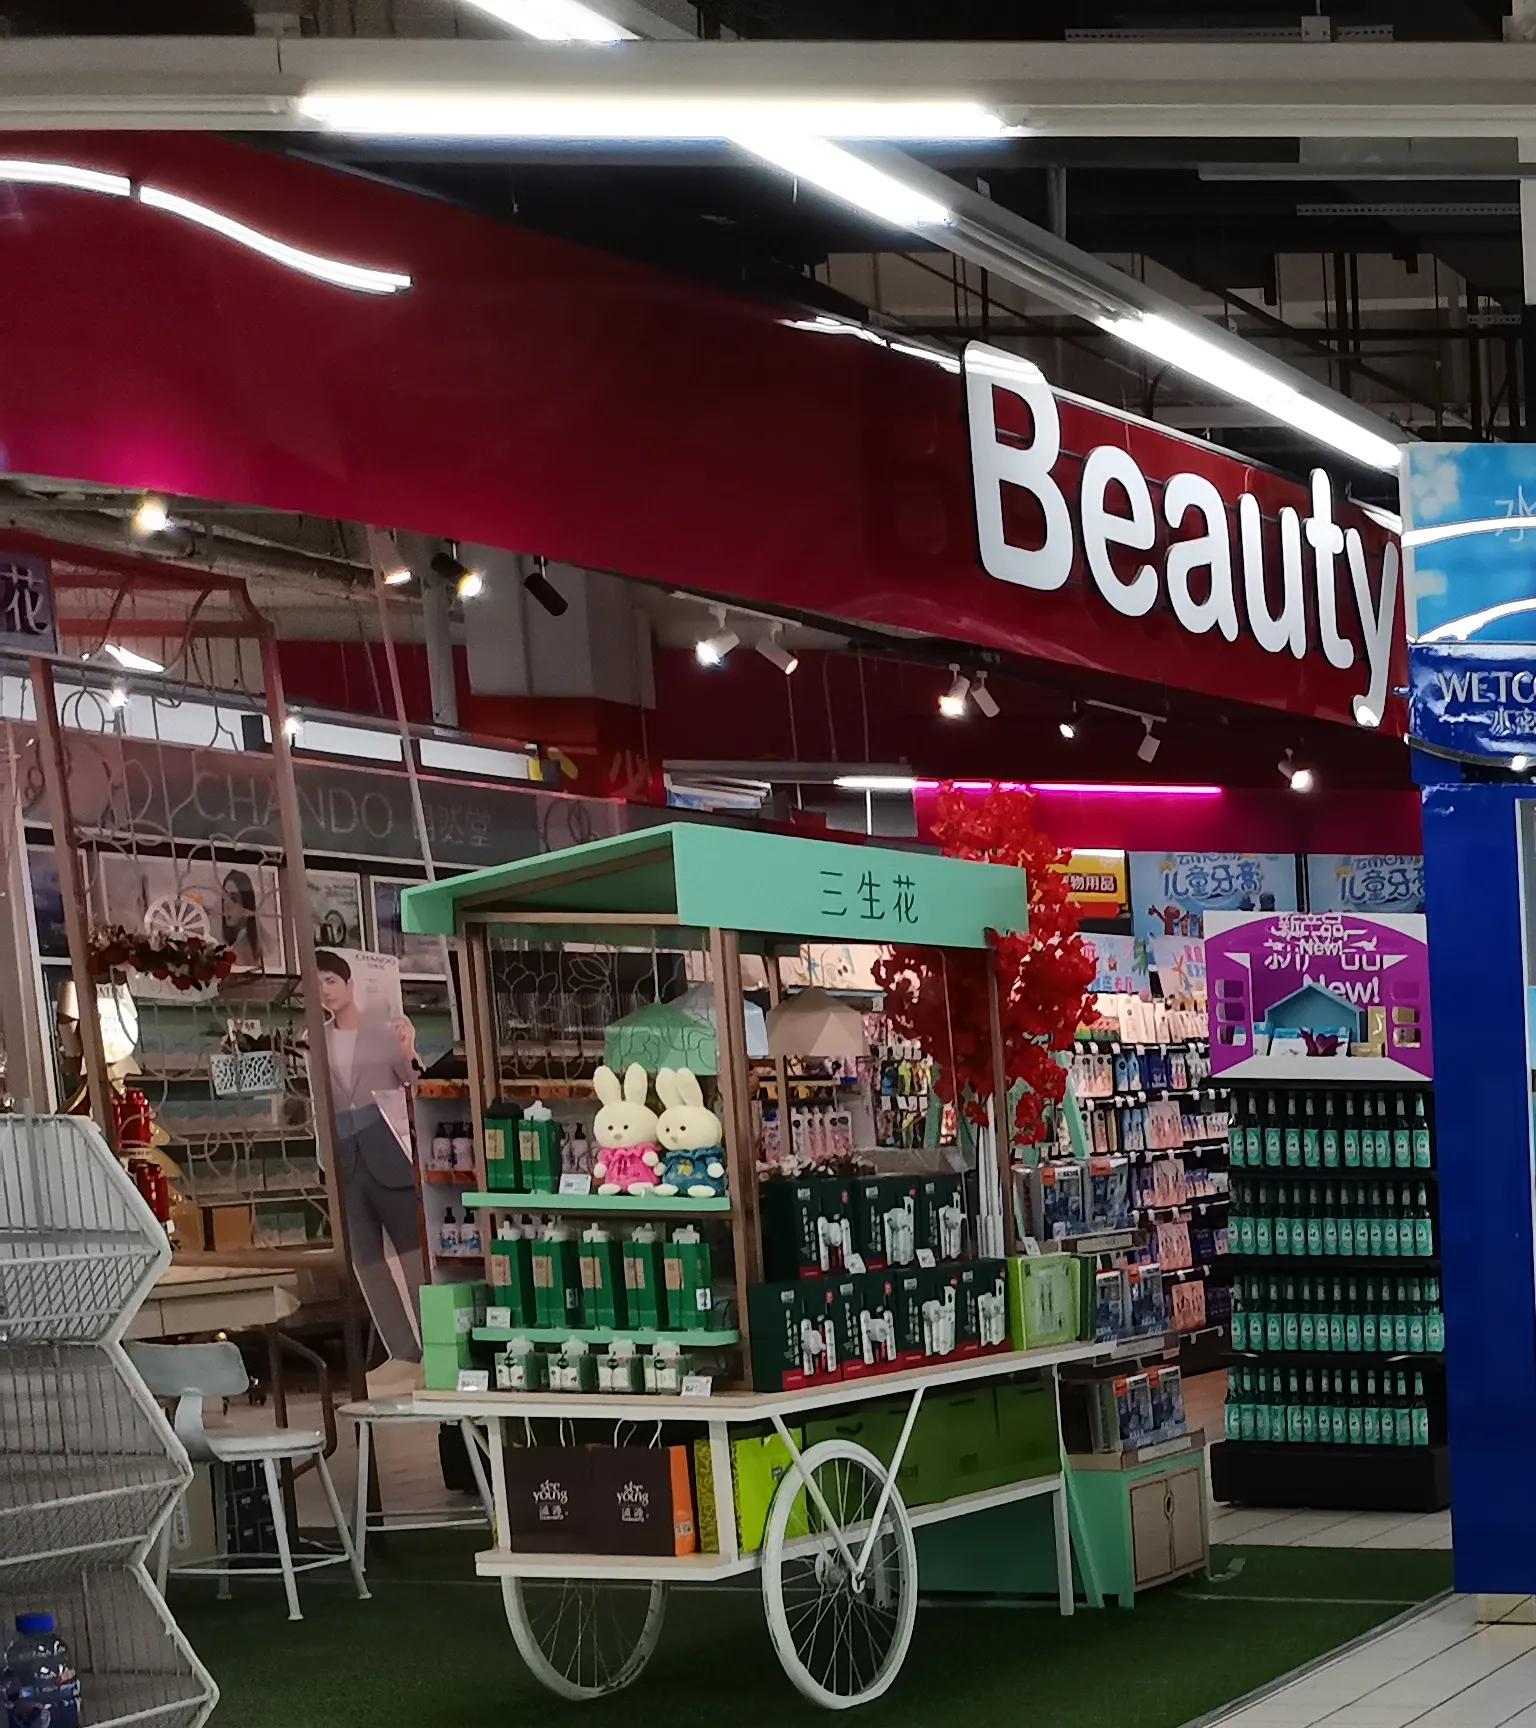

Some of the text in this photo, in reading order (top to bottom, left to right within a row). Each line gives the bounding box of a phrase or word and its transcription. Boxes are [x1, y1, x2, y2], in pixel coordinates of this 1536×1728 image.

[963, 340, 1398, 728] Beauty
[820, 869, 919, 923] 三生花
[1164, 862, 1263, 901] 儿童牙膏
[532, 1489, 568, 1505] young
[616, 1490, 650, 1507] young
